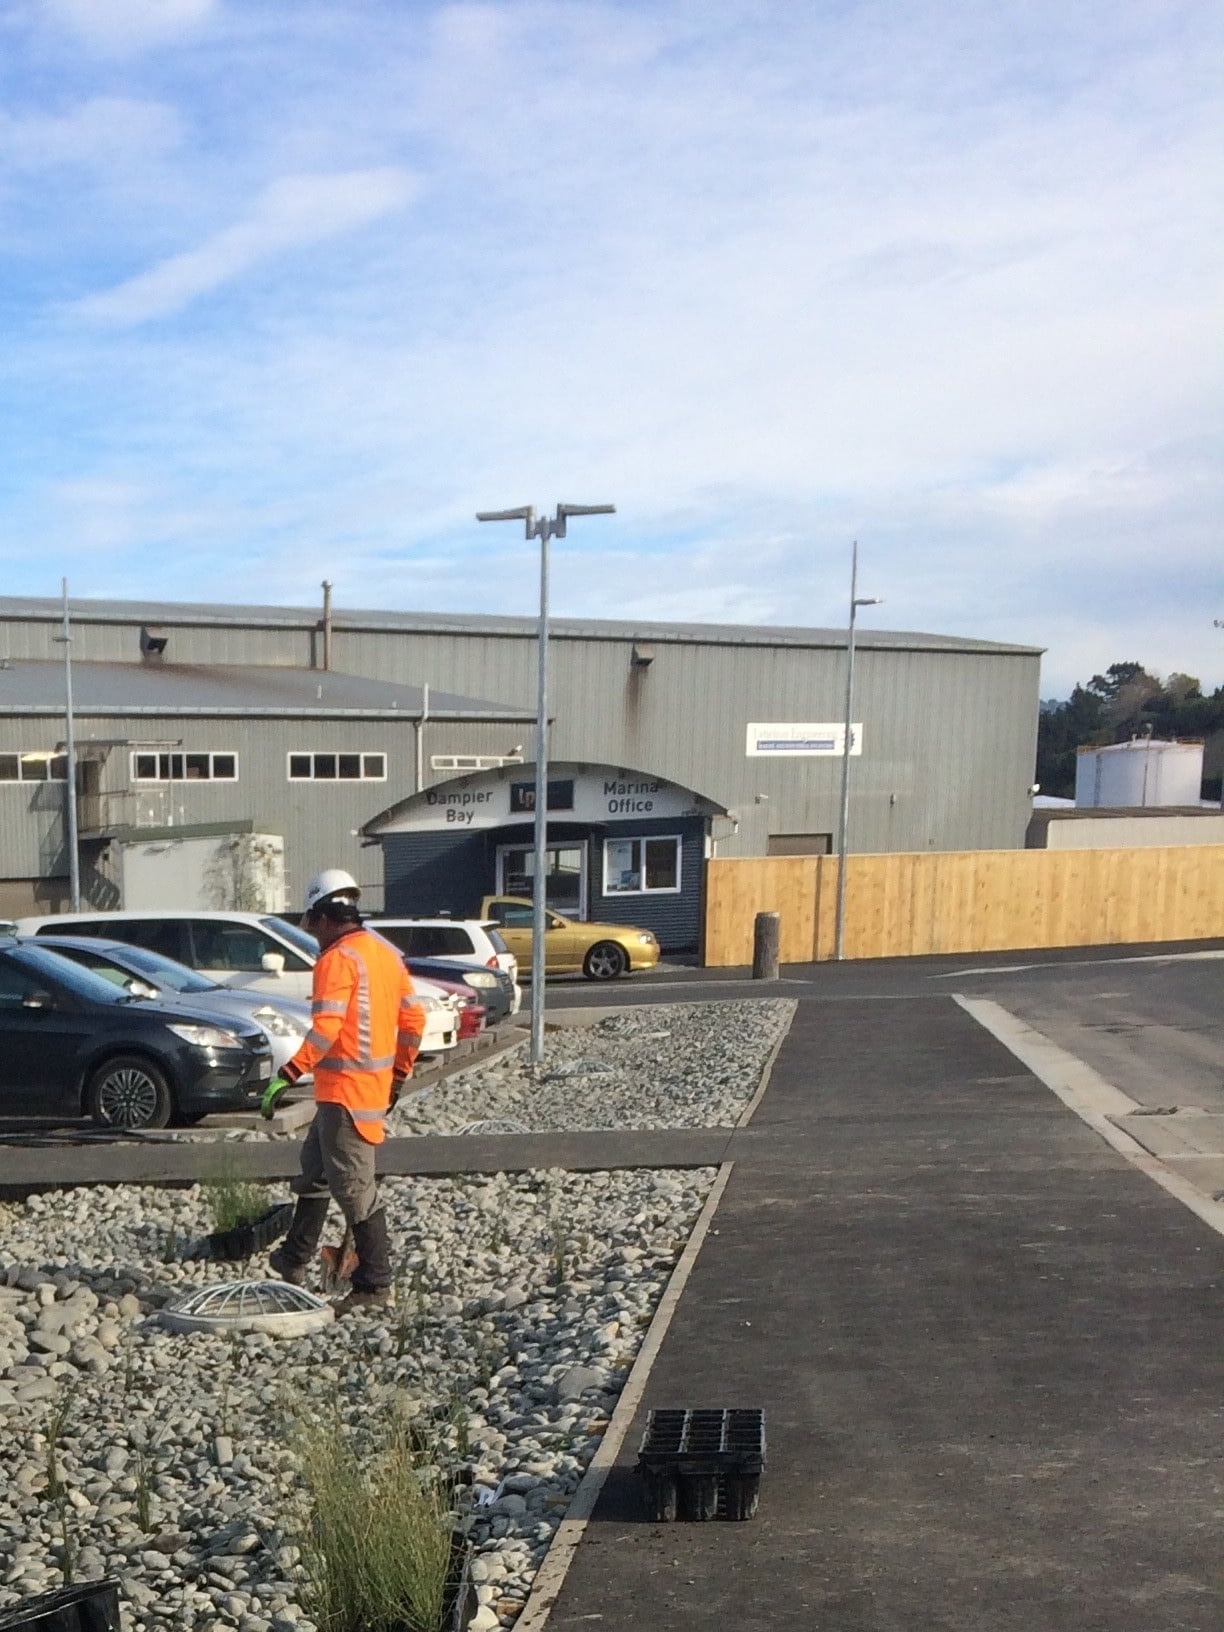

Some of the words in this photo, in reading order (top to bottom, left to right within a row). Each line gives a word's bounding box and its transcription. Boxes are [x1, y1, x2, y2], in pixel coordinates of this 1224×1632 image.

[604, 781, 658, 795] Marina
[426, 790, 493, 806] Dampier
[608, 799, 653, 813] Office
[446, 809, 474, 824] Bay
